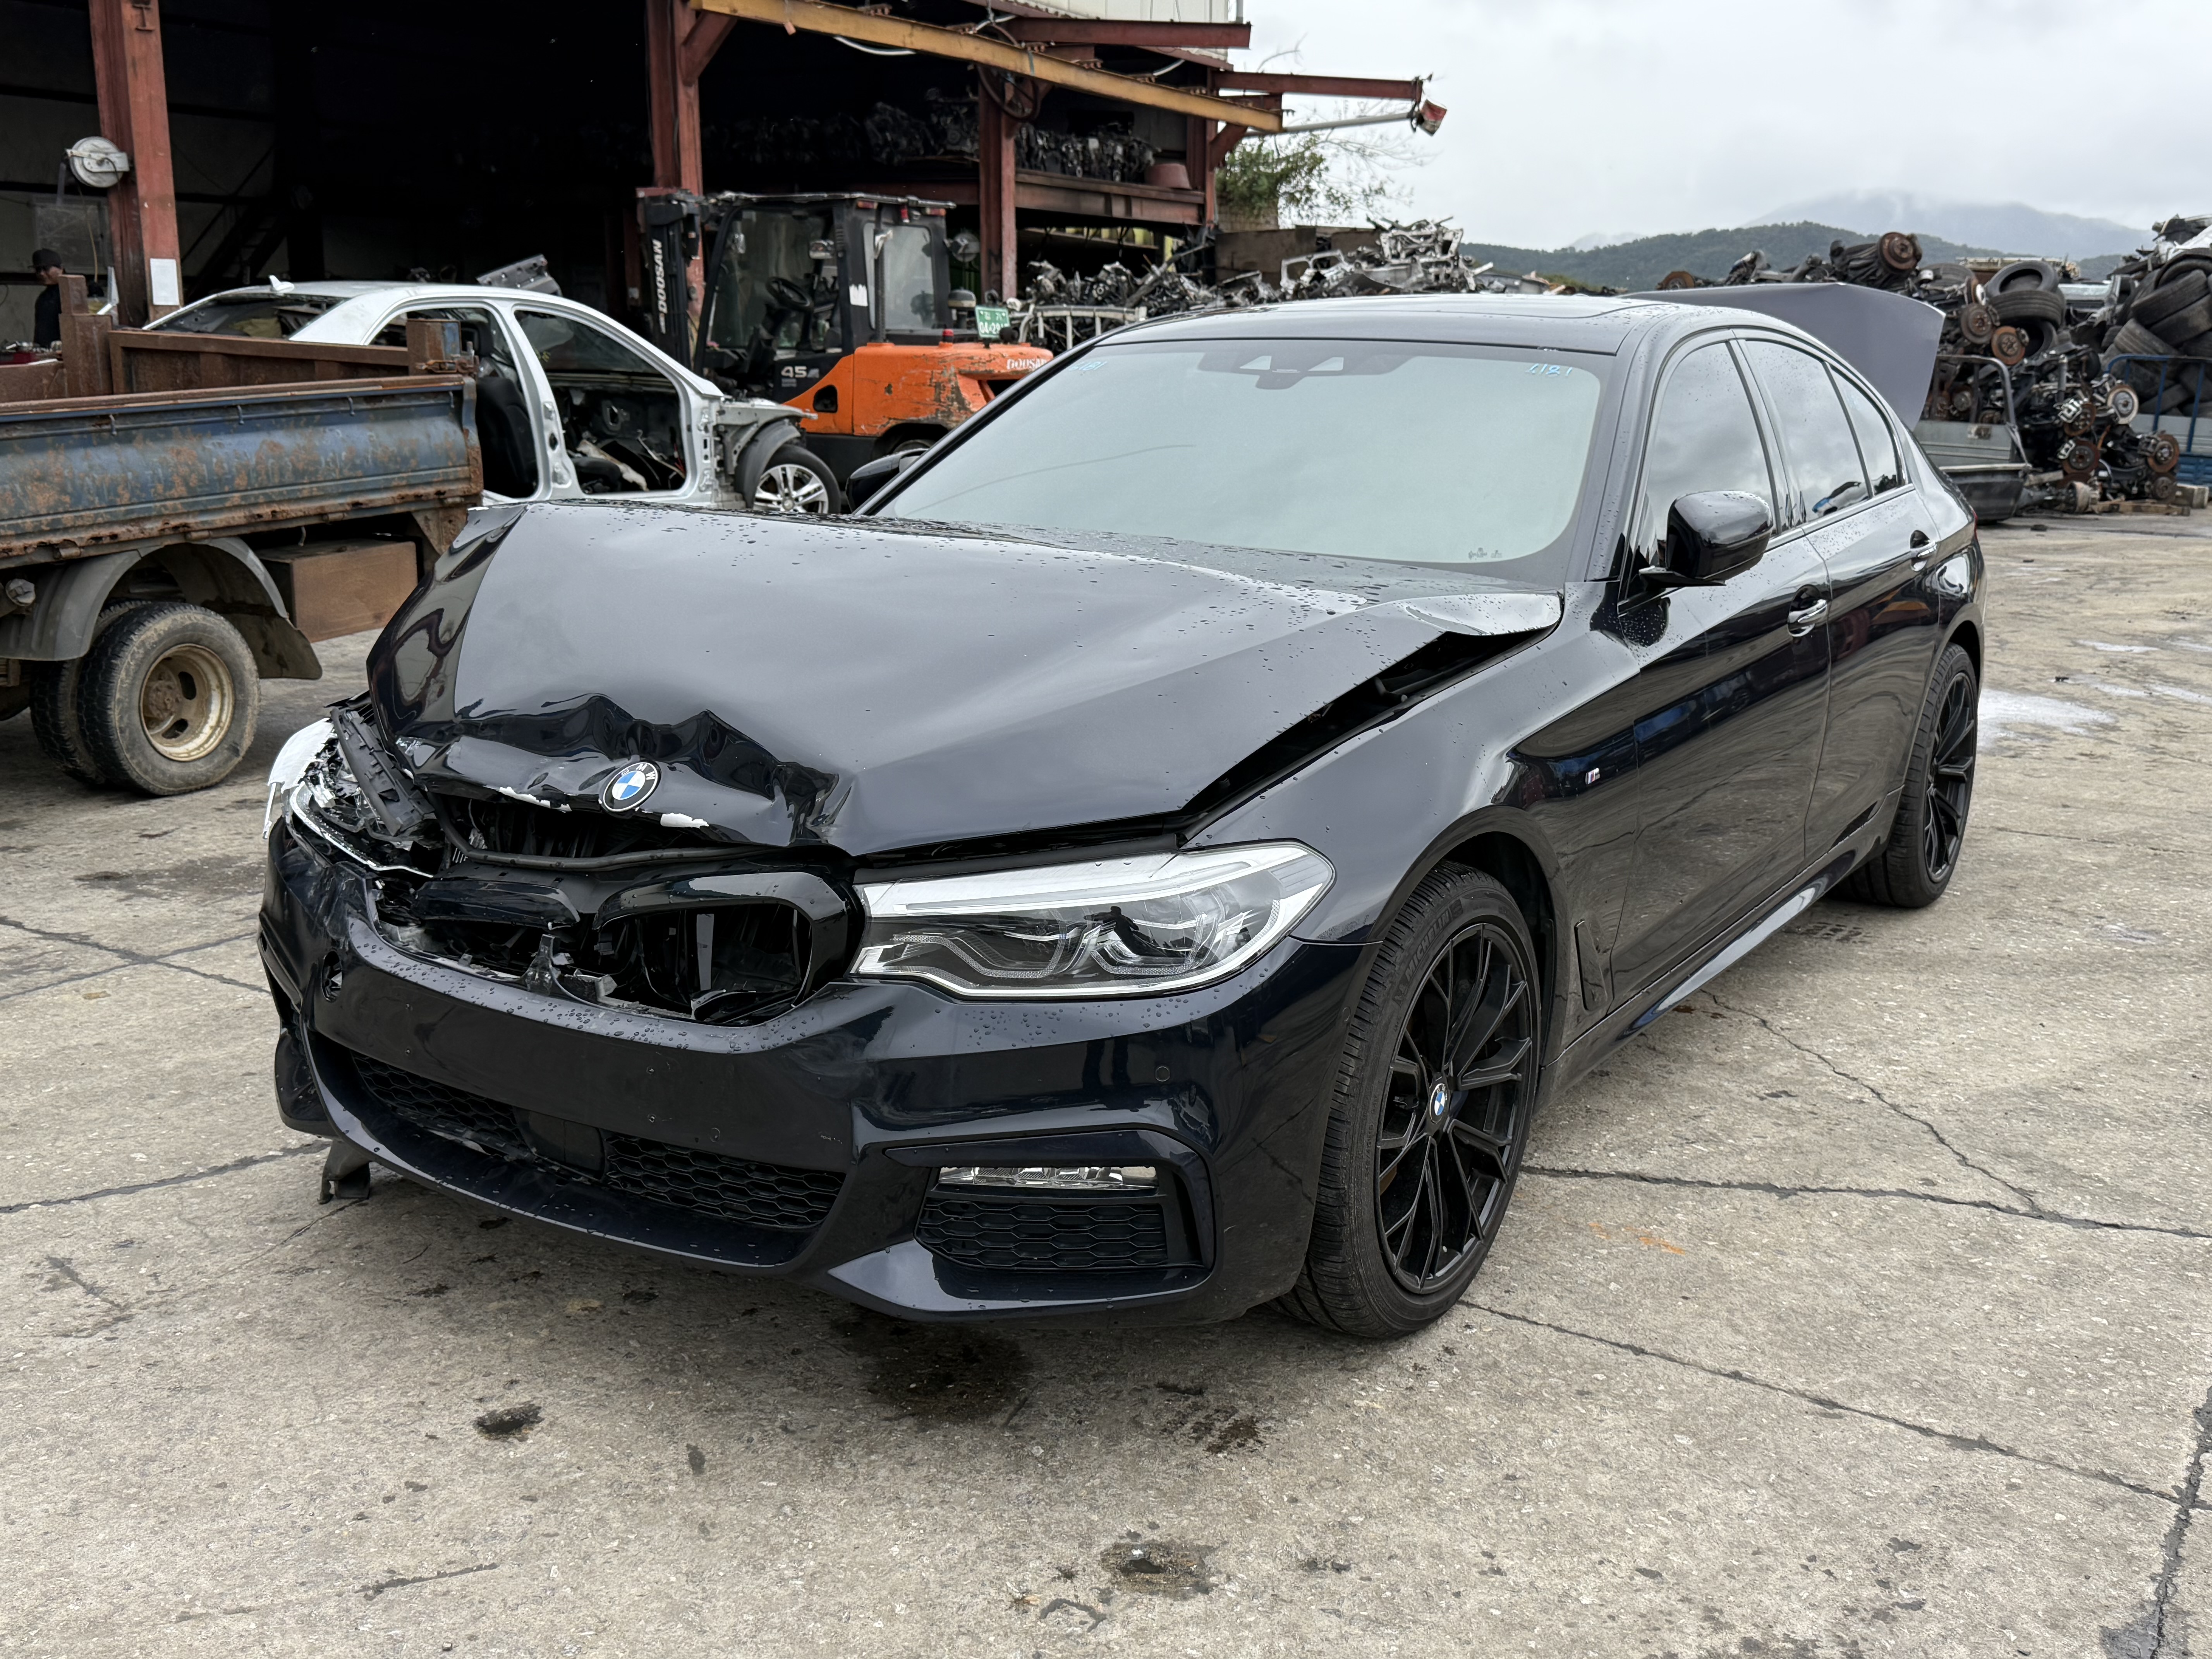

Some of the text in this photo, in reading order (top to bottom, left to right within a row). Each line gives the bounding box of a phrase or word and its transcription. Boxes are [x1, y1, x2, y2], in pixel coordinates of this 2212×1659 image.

[652, 239, 668, 314] DOOSAN
[621, 764, 656, 780] BMW
[1405, 909, 1451, 982] MICHELIN
